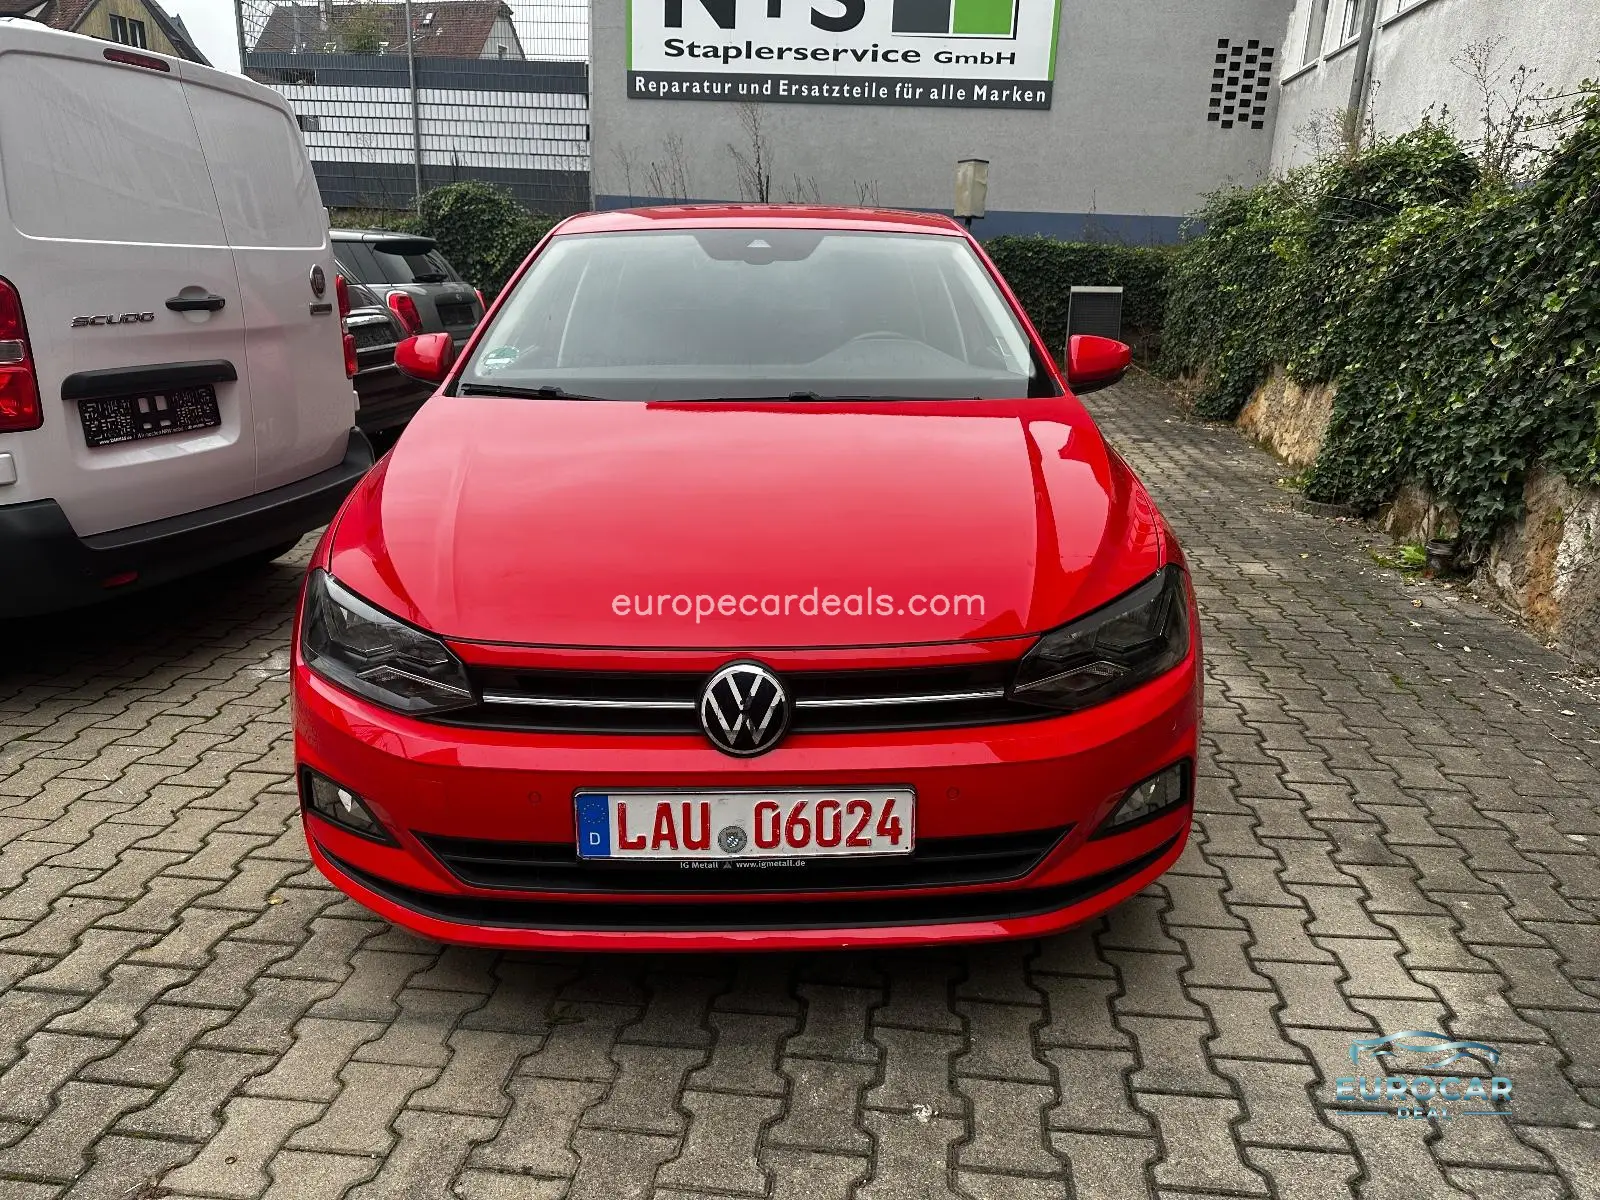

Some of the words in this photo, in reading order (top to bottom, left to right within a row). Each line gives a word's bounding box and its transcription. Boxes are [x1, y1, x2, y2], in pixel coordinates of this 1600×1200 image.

[664, 38, 921, 64] Staplerservice
[933, 51, 1016, 65] GmbH
[635, 76, 732, 96] Reparatur
[739, 80, 772, 95] und
[779, 80, 888, 98] Ersatzteile
[895, 83, 923, 99] für
[929, 84, 966, 100] alle
[973, 84, 1046, 102] Marken
[71, 312, 155, 328] SCUDO
[702, 663, 789, 755] VW
[617, 801, 711, 850] LAU
[753, 798, 903, 851] 06024
[589, 832, 601, 845] D
[680, 861, 690, 869] IG
[691, 861, 719, 869] Metall
[736, 860, 806, 869] www.igmetall.de
